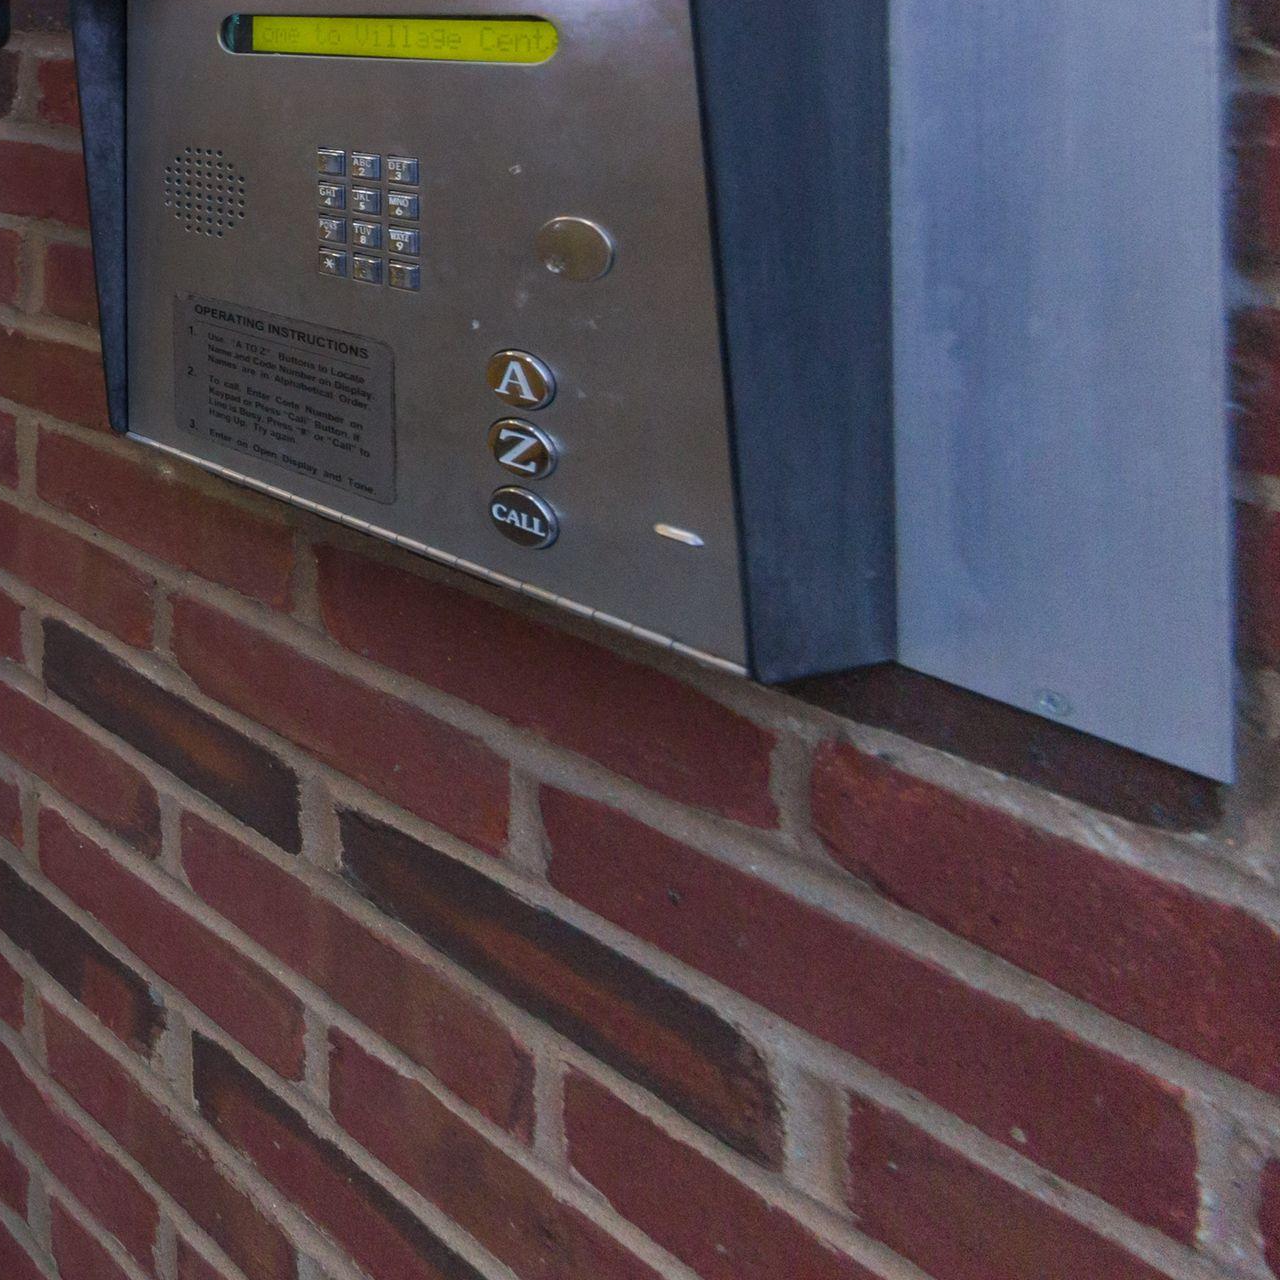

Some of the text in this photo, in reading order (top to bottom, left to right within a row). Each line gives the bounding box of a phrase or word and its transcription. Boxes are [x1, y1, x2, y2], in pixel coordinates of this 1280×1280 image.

[316, 23, 341, 46] to
[355, 24, 462, 50] Village
[352, 158, 371, 167] ABC
[359, 168, 365, 176] 2
[395, 172, 401, 180] 3
[319, 187, 336, 197] GHI
[324, 198, 331, 206] 4
[353, 193, 370, 202] JKL
[359, 202, 365, 211] 5
[395, 208, 403, 216] 6
[324, 230, 331, 239] 7
[354, 225, 371, 235] TUV
[360, 236, 366, 244] 8
[396, 241, 404, 251] 9
[194, 304, 369, 359] OPERATING INSTRUCTIONS
[494, 360, 538, 401] A
[498, 428, 538, 472] Z
[491, 503, 546, 537] CALL
